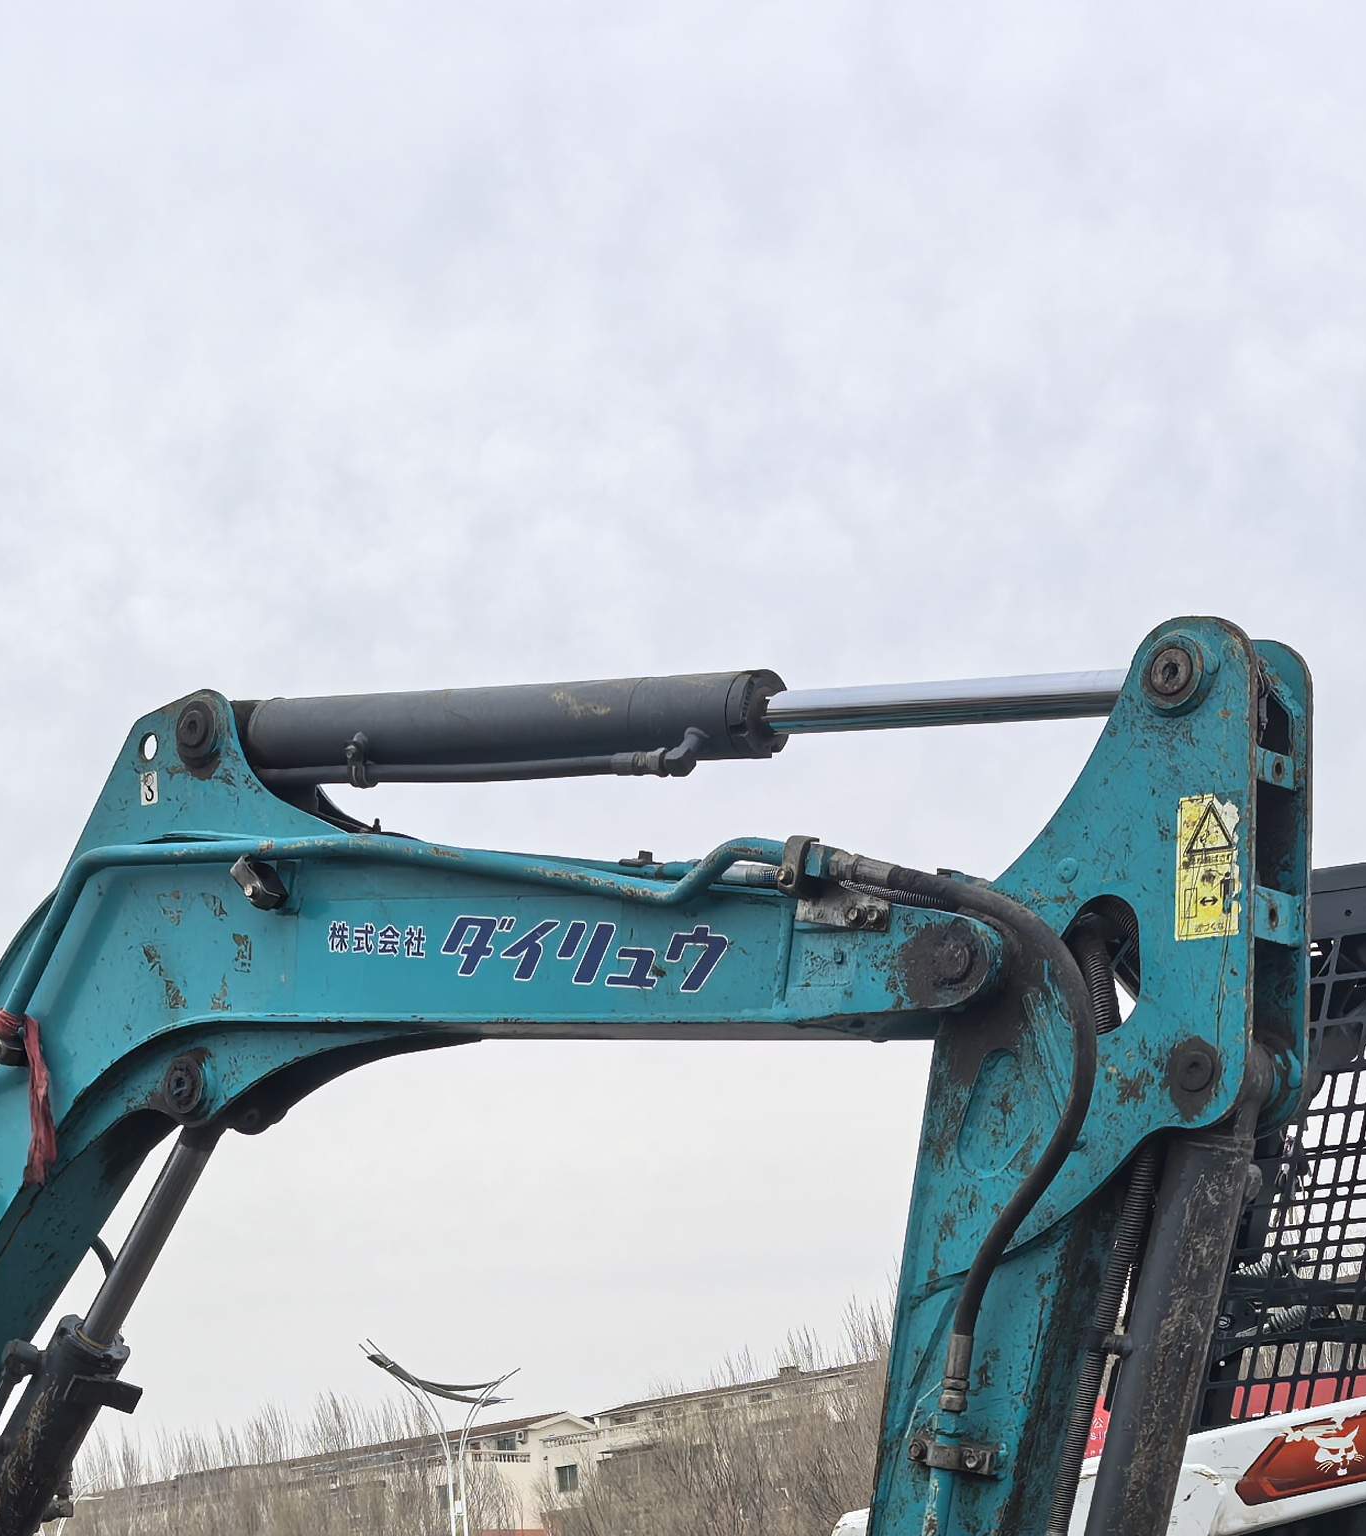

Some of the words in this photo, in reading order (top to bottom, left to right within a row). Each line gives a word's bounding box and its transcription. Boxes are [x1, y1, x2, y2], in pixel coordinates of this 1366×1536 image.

[327, 920, 426, 958] 株式会社
[441, 916, 729, 993] ダイリュウ
